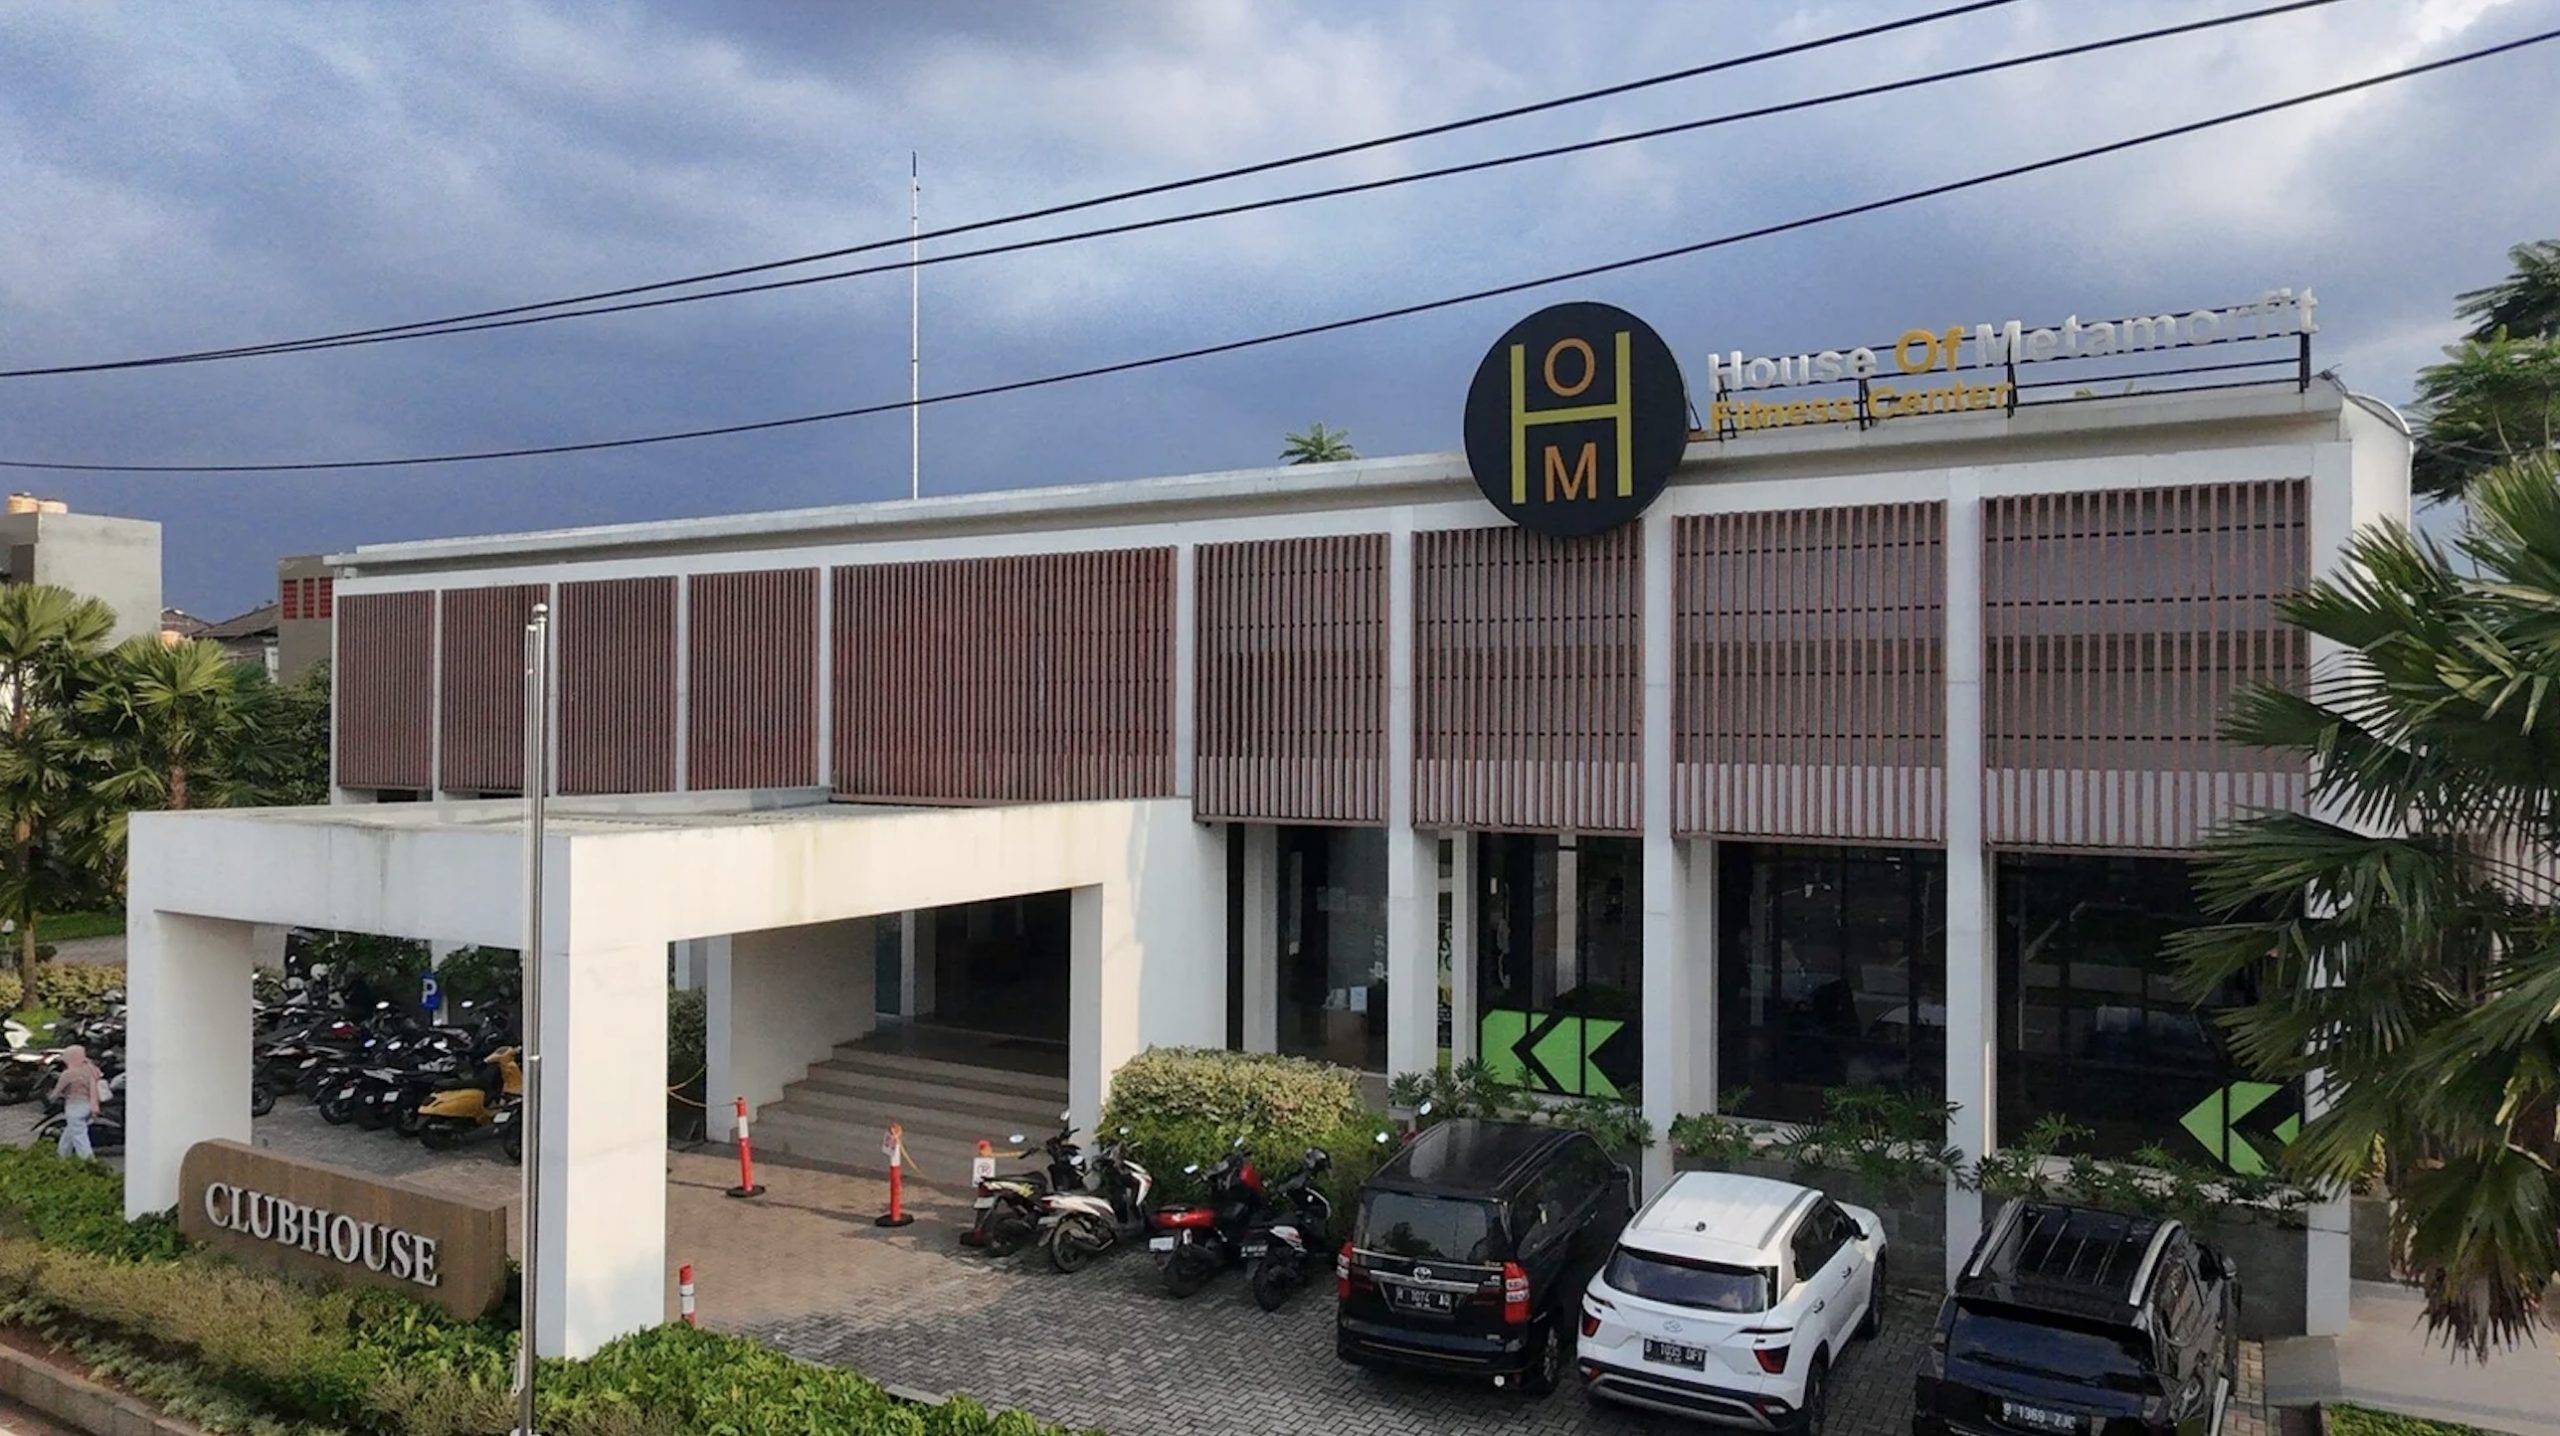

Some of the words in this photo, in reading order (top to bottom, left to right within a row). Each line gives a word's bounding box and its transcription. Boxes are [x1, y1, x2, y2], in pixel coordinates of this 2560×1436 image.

[1708, 347, 1878, 393] House
[1895, 326, 1965, 374] Of
[1709, 400, 1855, 432] Fitness
[1869, 380, 2013, 418] Center
[422, 978, 438, 1003] P
[205, 1182, 438, 1287] CLUBHOUSE
[2020, 1405, 2046, 1423] 1369
